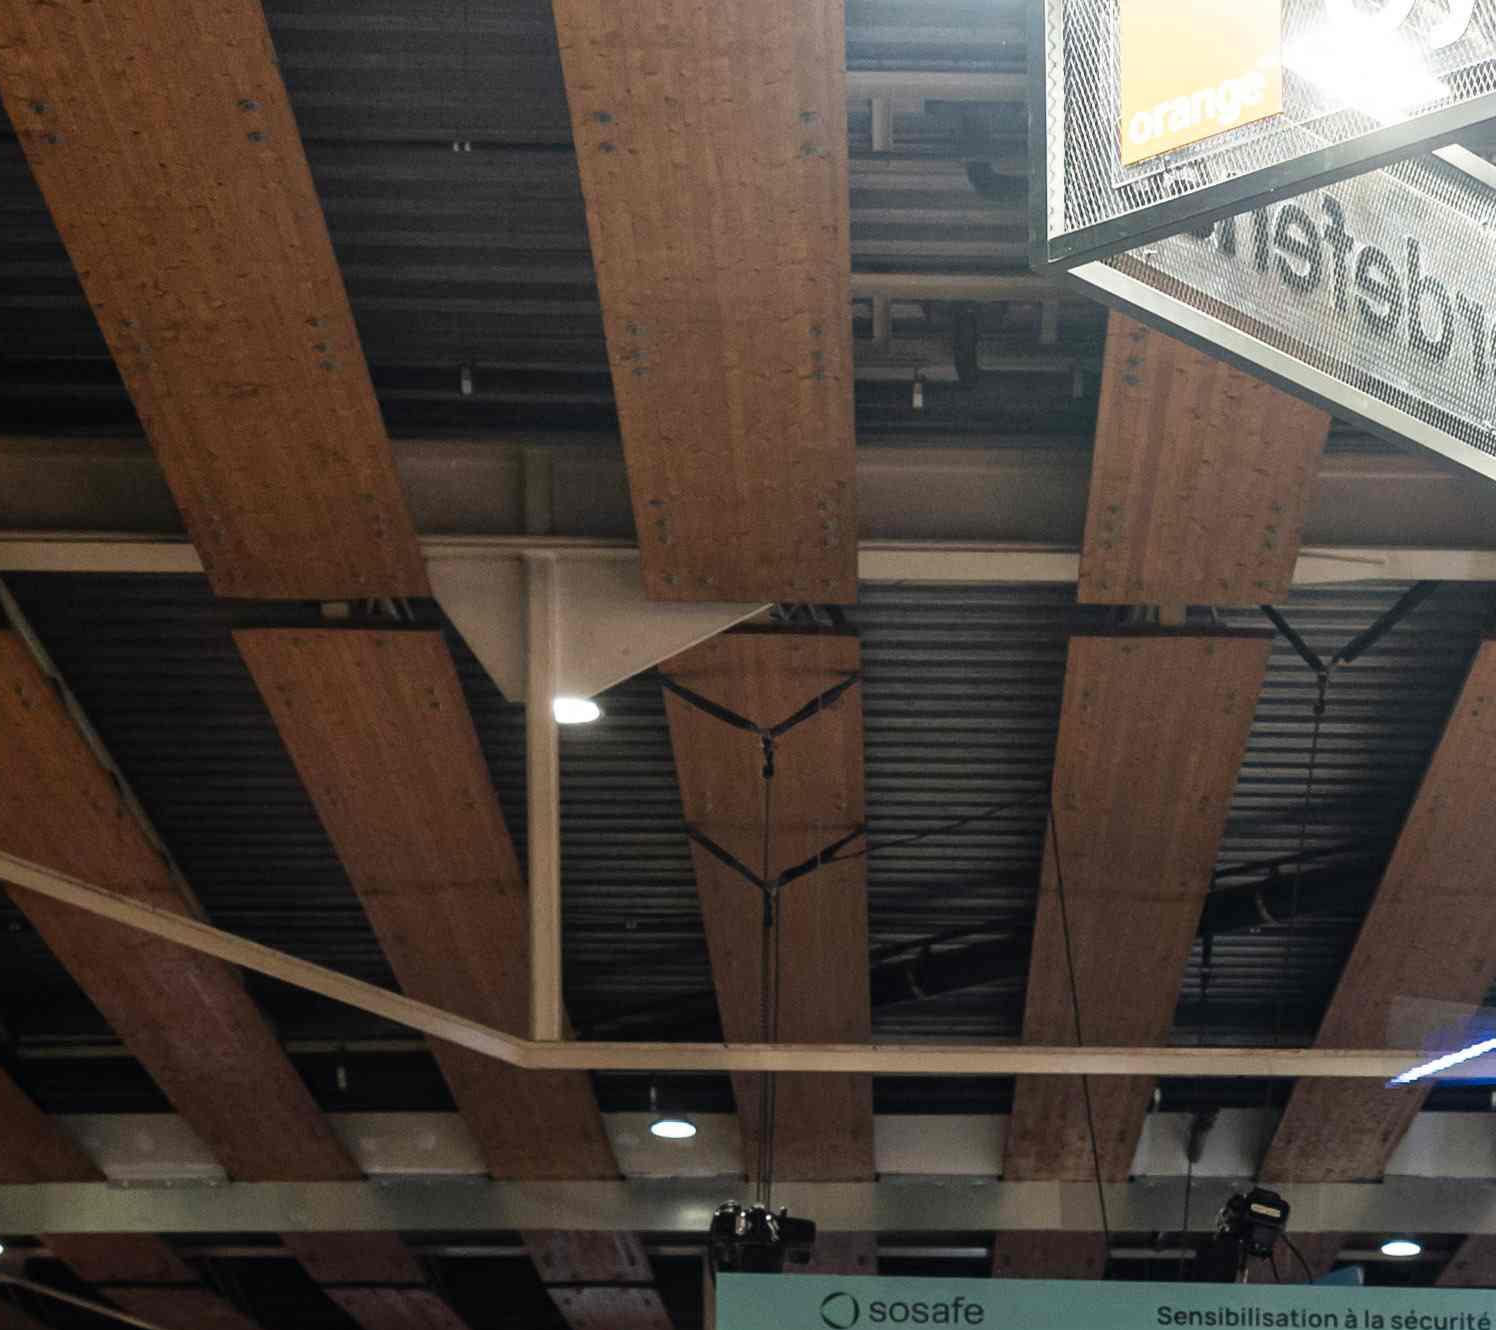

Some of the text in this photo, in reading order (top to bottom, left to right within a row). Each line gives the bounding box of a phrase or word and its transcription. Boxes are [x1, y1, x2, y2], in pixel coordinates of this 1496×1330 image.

[868, 1295, 985, 1325] sosafe
[1156, 1305, 1339, 1329] Sensibilisation
[1344, 1307, 1358, 1330] à
[1364, 1309, 1385, 1330] la
